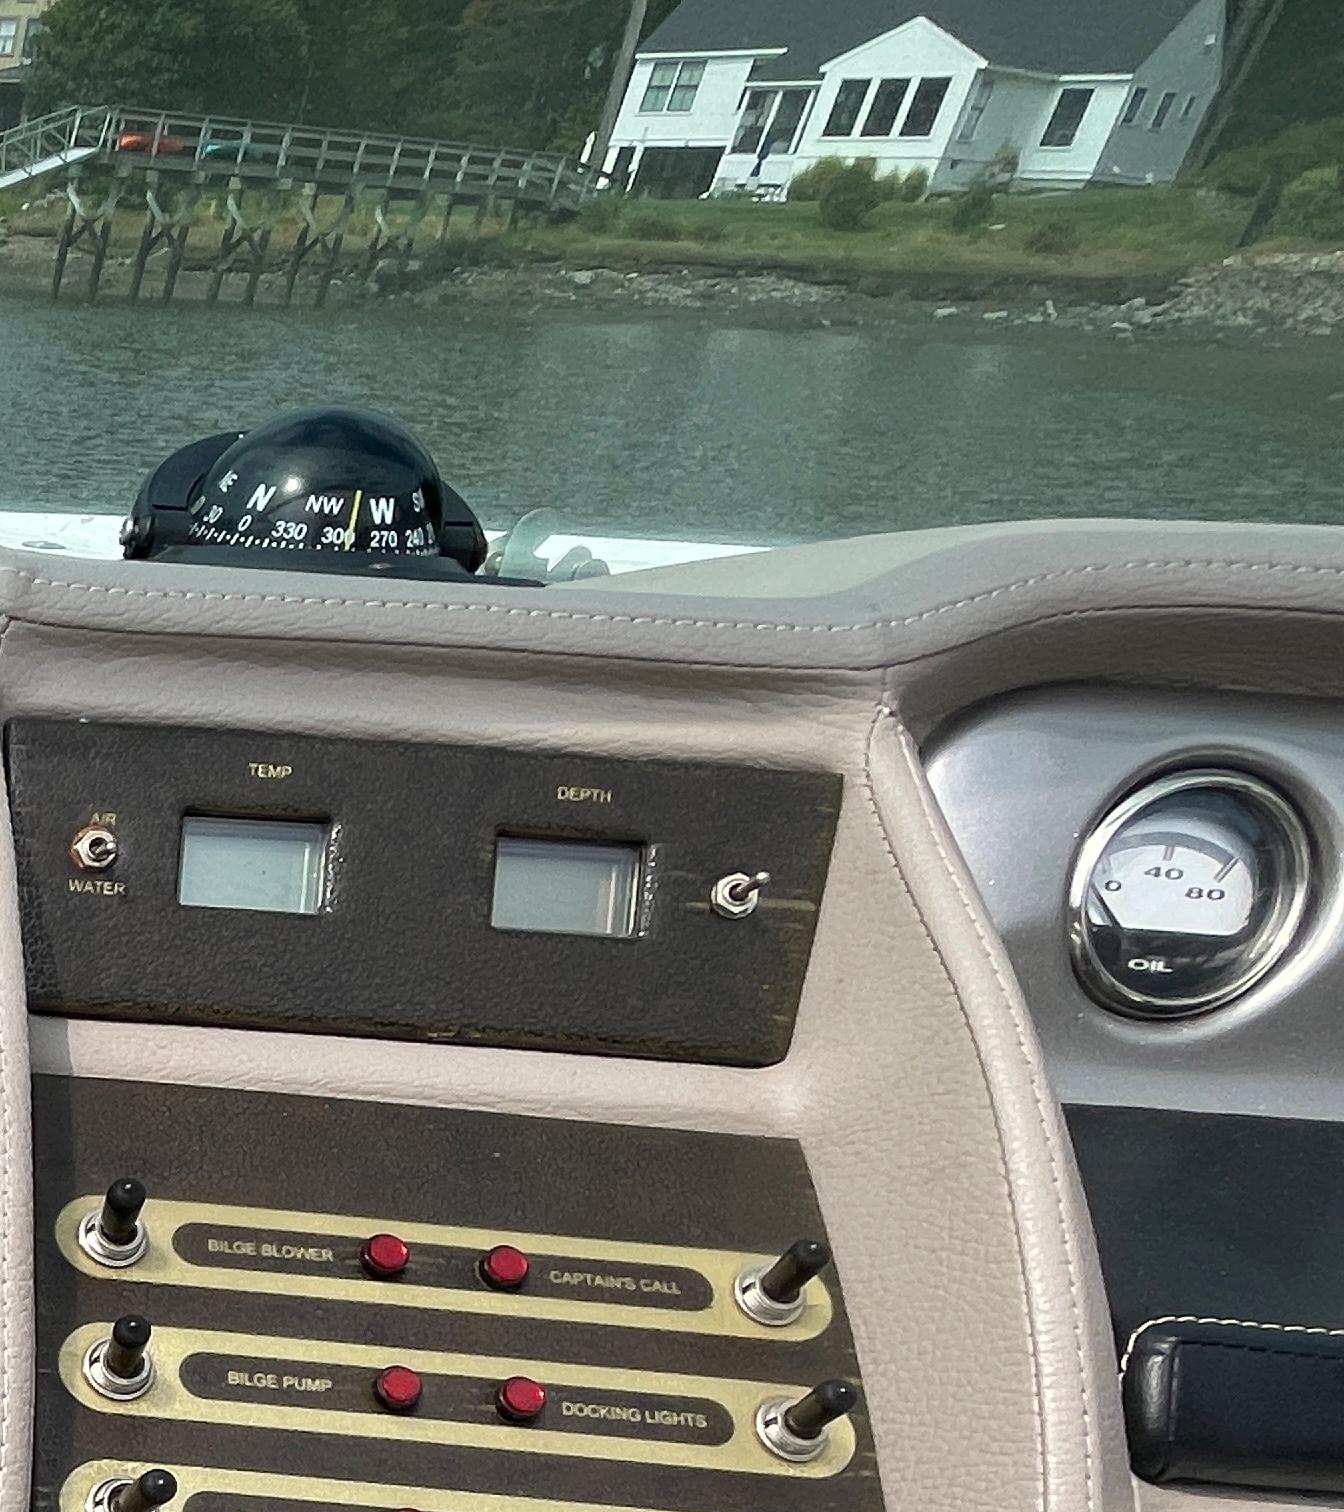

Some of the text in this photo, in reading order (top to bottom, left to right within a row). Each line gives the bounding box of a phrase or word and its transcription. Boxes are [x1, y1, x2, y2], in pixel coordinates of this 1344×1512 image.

[246, 483, 277, 512] N
[305, 494, 344, 515] NW
[369, 497, 395, 525] W
[238, 514, 252, 532] 0
[271, 520, 308, 540] 330
[321, 526, 355, 545] 300
[370, 530, 398, 548] 270
[248, 762, 293, 779] TEMP
[557, 786, 612, 803] DEPTH
[90, 812, 117, 827] AIR
[68, 879, 128, 896] WATER
[1104, 865, 1226, 901] 0 40 80
[1127, 958, 1173, 973] OIL
[207, 1238, 334, 1263] BILGE BLOWER
[640, 1277, 681, 1295] CALL
[227, 1370, 333, 1393] BILGE PUMP
[561, 1402, 708, 1428] DOCKING LIGHTS
